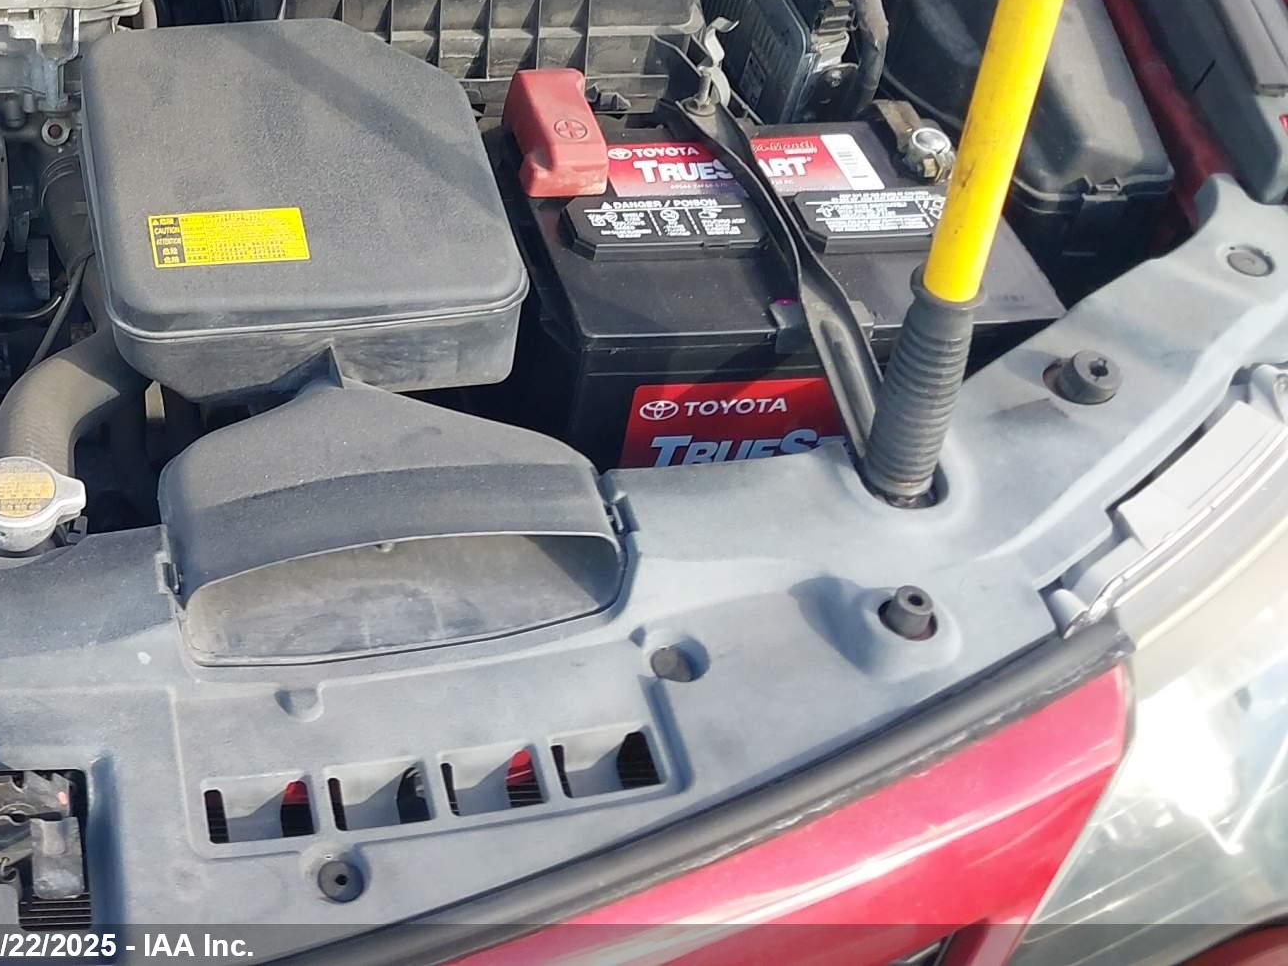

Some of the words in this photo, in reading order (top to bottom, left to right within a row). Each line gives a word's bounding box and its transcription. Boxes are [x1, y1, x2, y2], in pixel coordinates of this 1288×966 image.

[632, 146, 700, 159] TOYOTA
[613, 200, 662, 210] DANGER
[664, 199, 671, 208] /
[672, 198, 718, 208] POISON
[684, 397, 788, 417] TOYOTA
